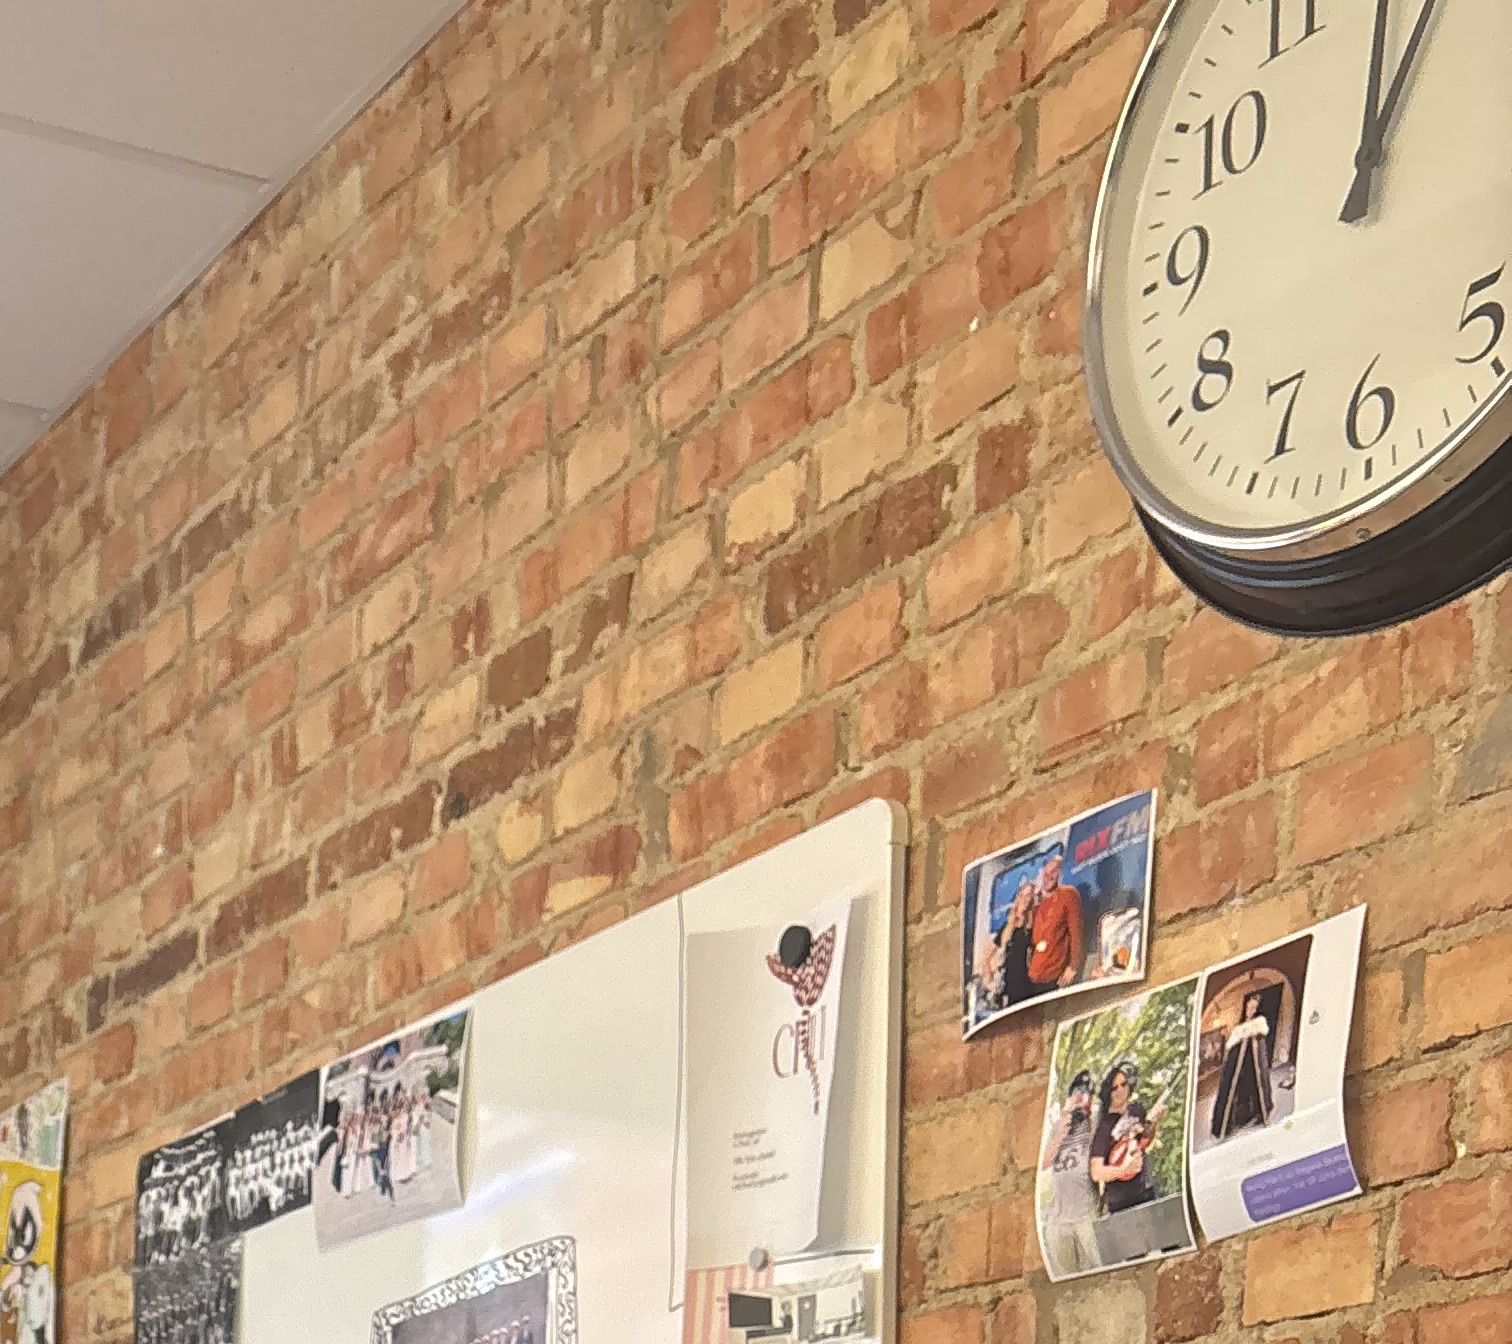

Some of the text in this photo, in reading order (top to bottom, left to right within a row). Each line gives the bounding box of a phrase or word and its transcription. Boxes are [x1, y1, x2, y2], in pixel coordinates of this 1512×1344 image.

[1192, 89, 1267, 200] 10
[1166, 225, 1209, 317] 9
[1454, 261, 1506, 364] 5
[1190, 329, 1233, 413] 8
[1264, 369, 1307, 464] 7
[1344, 353, 1396, 451] 6
